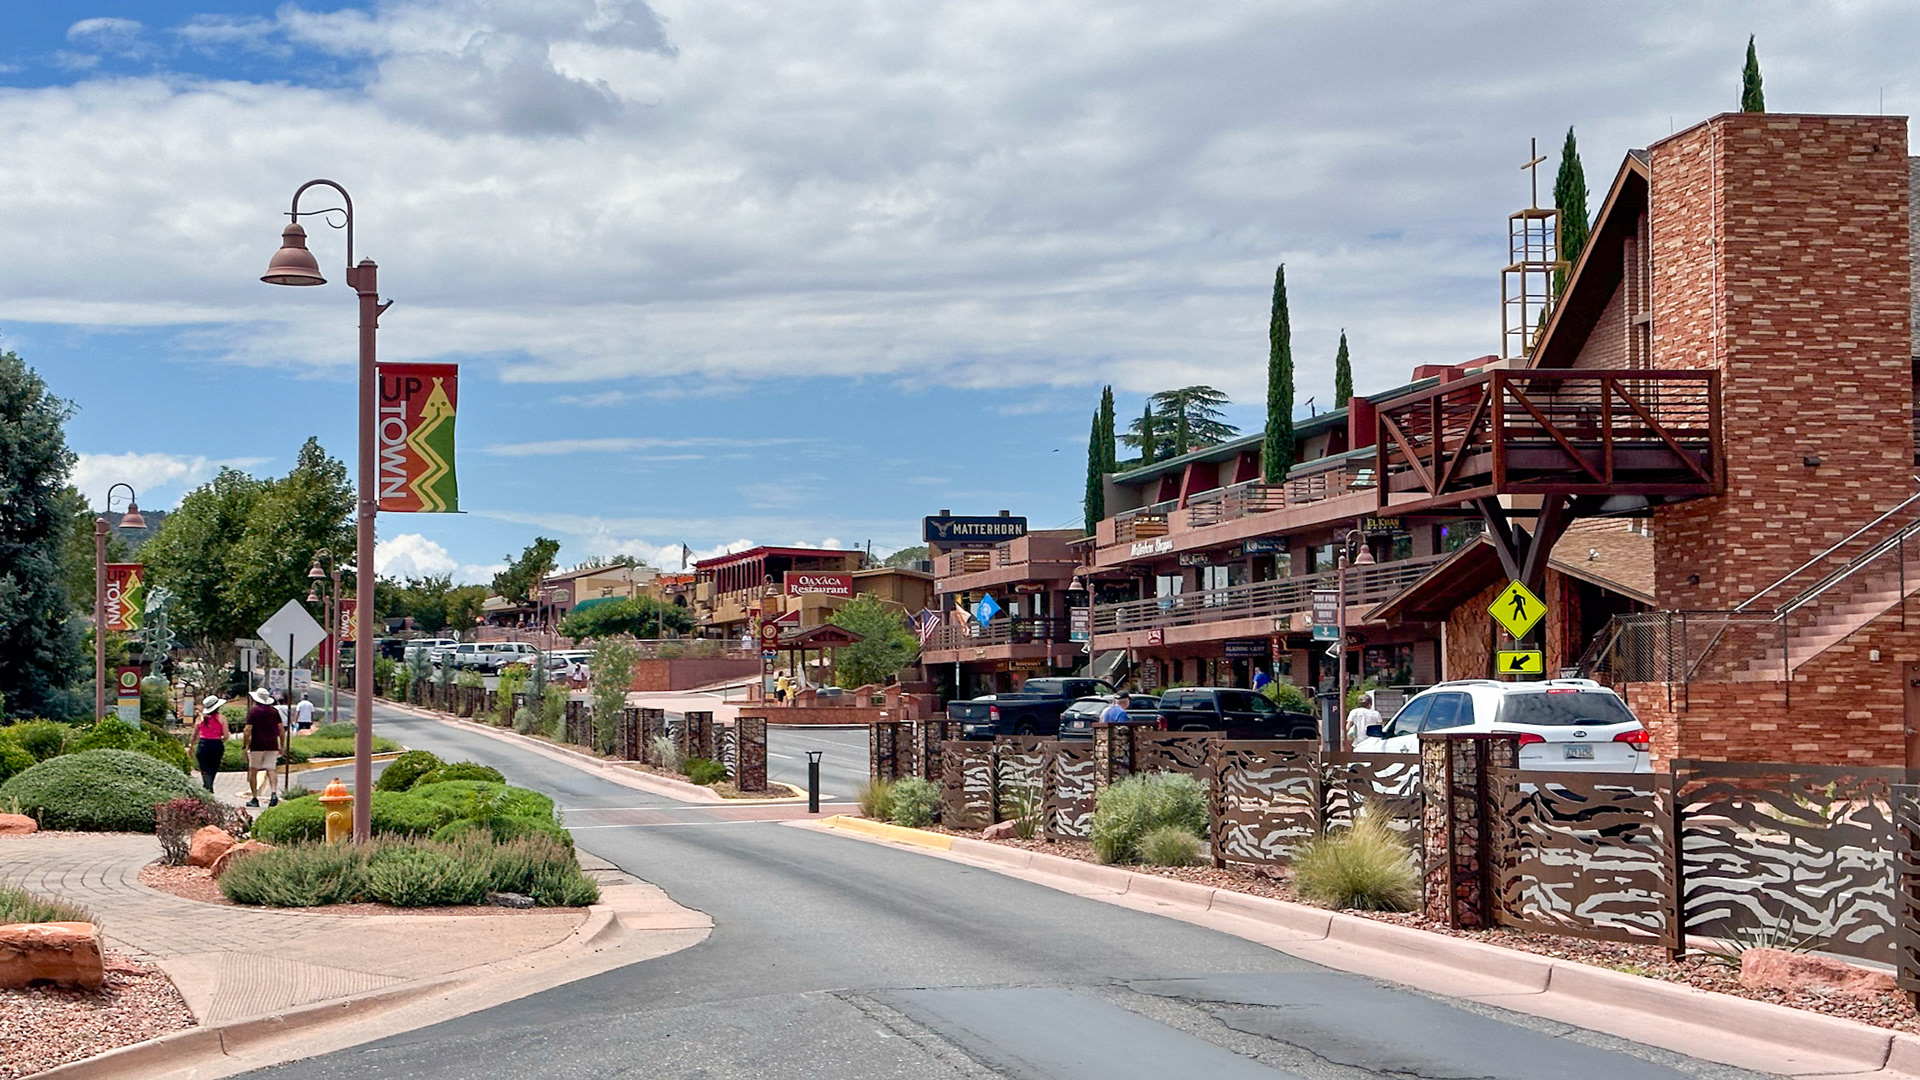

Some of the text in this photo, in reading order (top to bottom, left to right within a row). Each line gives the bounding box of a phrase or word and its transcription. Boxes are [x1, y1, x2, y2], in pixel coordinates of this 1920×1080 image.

[381, 377, 422, 402] UP
[380, 400, 408, 498] TOWN
[952, 523, 1023, 535] MATTERHORN
[107, 580, 121, 625] TOWN
[790, 584, 849, 595] Restaurant
[341, 609, 350, 638] TOWN
